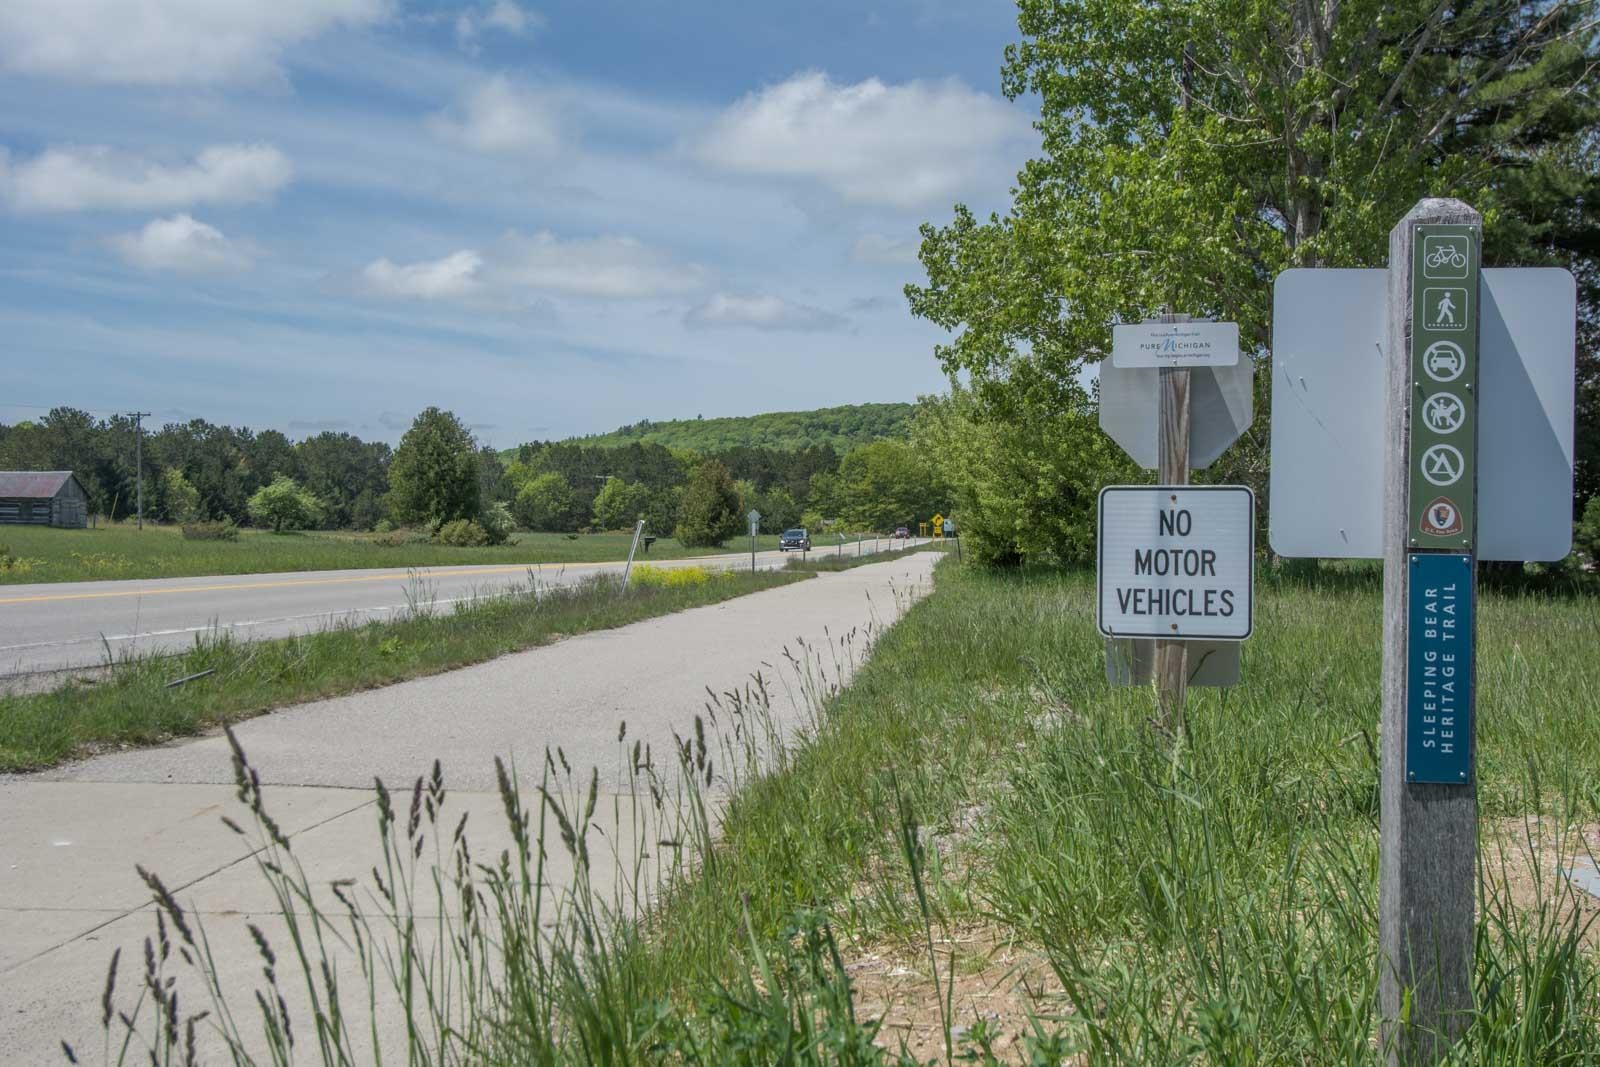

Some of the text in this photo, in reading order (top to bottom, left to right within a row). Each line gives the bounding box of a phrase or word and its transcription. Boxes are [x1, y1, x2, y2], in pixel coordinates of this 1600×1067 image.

[1161, 337, 1211, 352] MICHIGAN
[1159, 509, 1192, 536] NO
[1135, 549, 1216, 576] MOTOR
[1117, 588, 1234, 617] VEHICLES
[1423, 588, 1438, 748] SLEEPING BEAR
[1441, 583, 1456, 753] HERITAGE TRAIL
